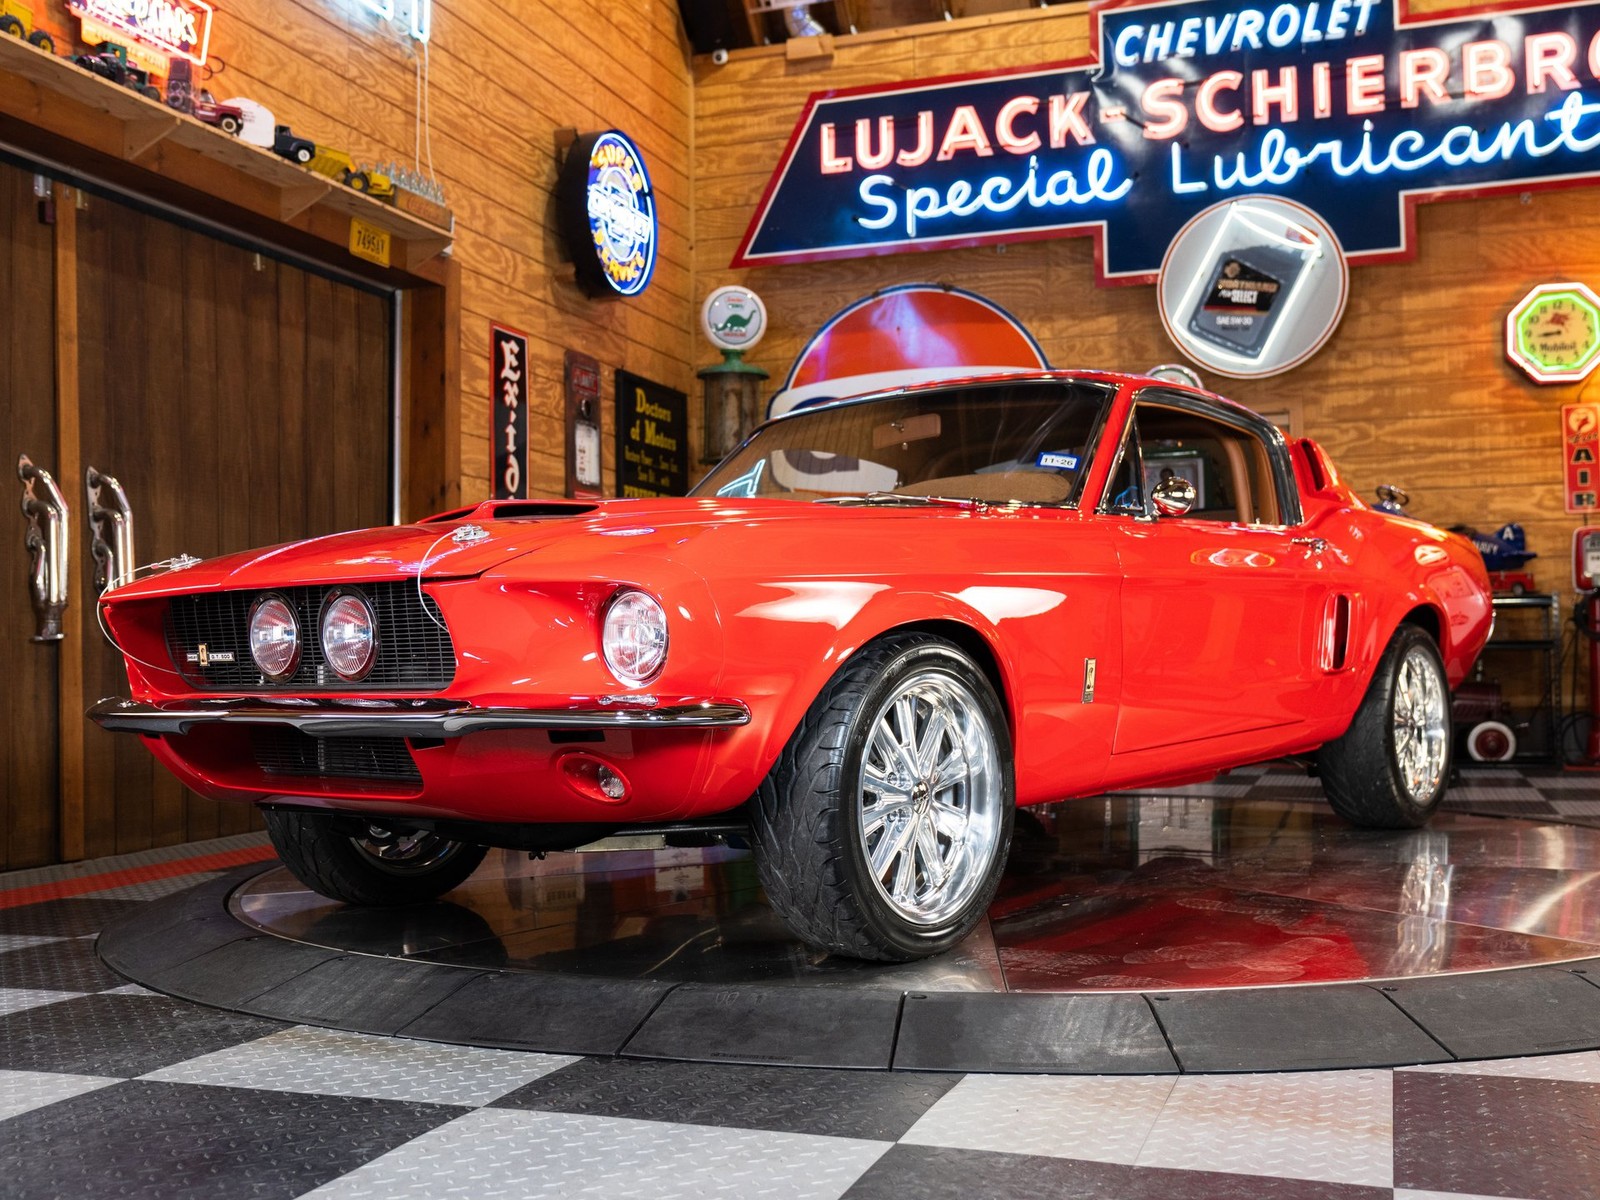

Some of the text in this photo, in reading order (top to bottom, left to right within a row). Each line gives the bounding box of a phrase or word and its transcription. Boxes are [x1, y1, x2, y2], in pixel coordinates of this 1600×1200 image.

[1114, 0, 1380, 66] CHEVROLET
[858, 148, 1134, 237] Special
[501, 339, 521, 500] Exid
[635, 387, 672, 423] Doctors
[630, 419, 677, 452] of Motors
[1043, 456, 1074, 467] 11-26
[1570, 447, 1597, 509] AIR
[1502, 526, 1515, 541] A
